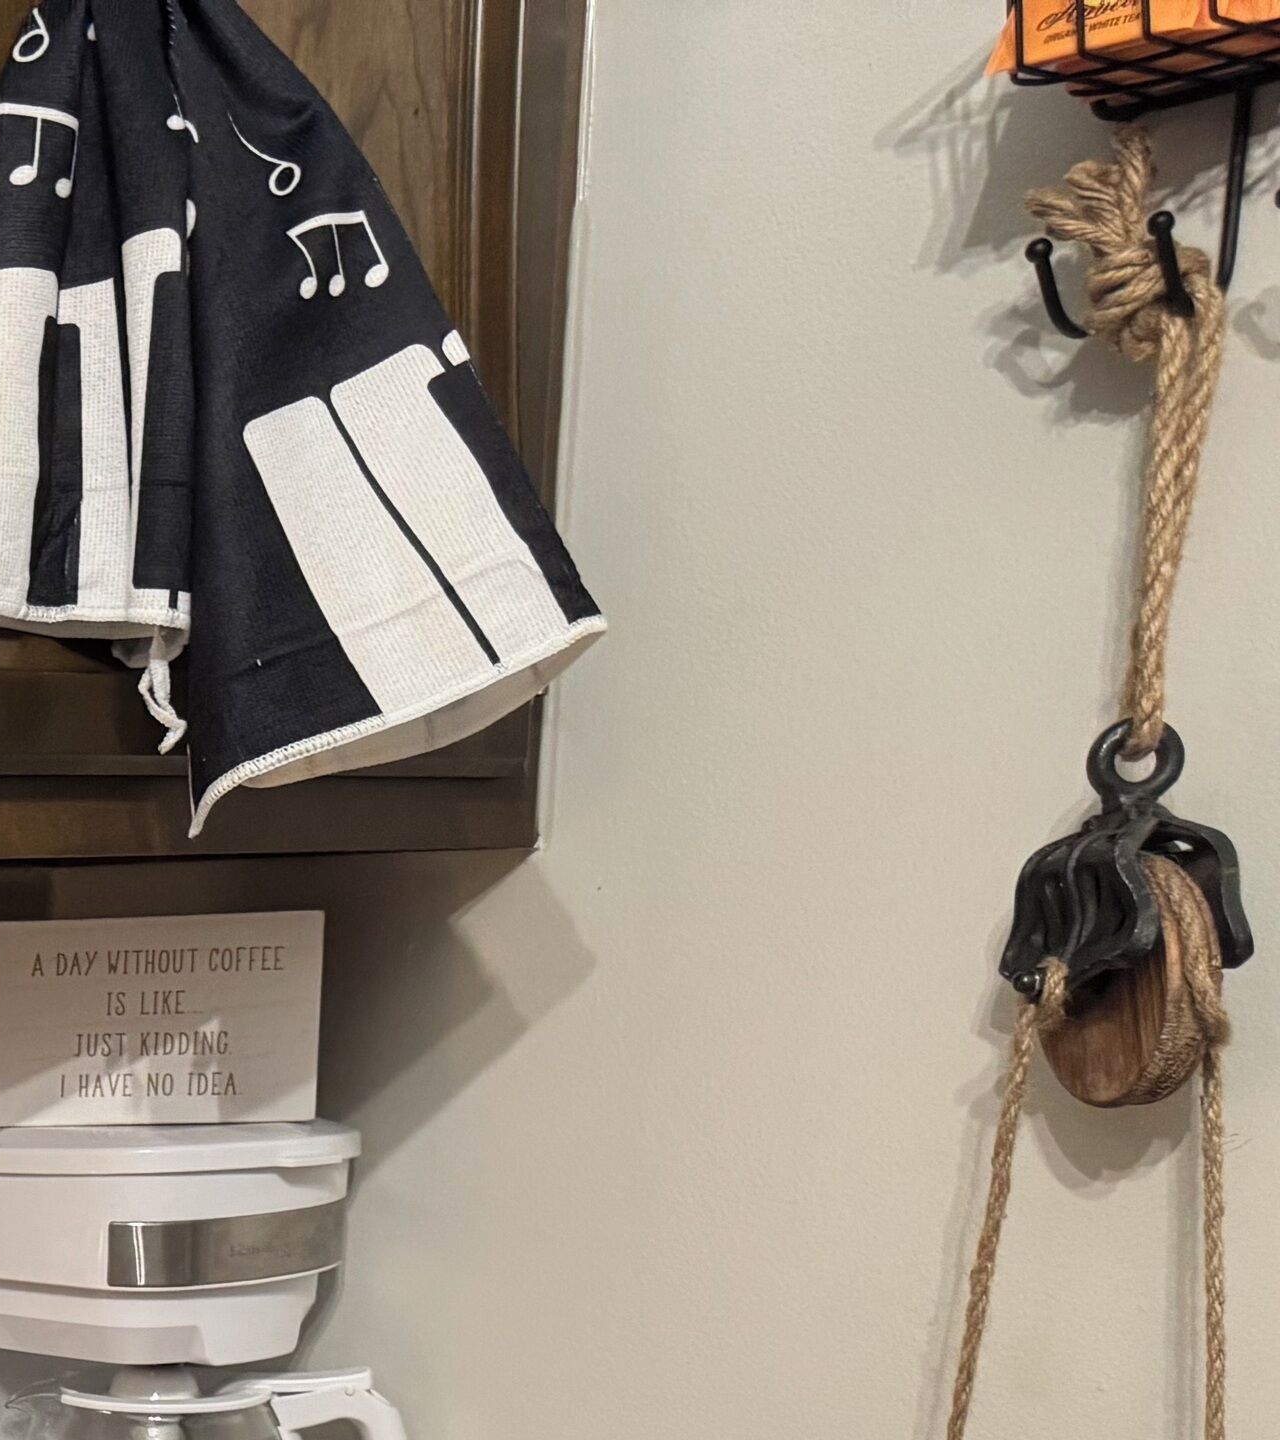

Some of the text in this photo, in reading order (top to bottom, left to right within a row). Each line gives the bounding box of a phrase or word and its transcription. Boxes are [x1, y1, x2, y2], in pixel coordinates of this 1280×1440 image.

[31, 945, 286, 977] A DAY WITHOUT COFFEE
[105, 991, 127, 1016] IS
[74, 1032, 128, 1057] JUST
[60, 1074, 65, 1098] I
[78, 1071, 134, 1098] HAVE
[146, 1071, 175, 1097] NO
